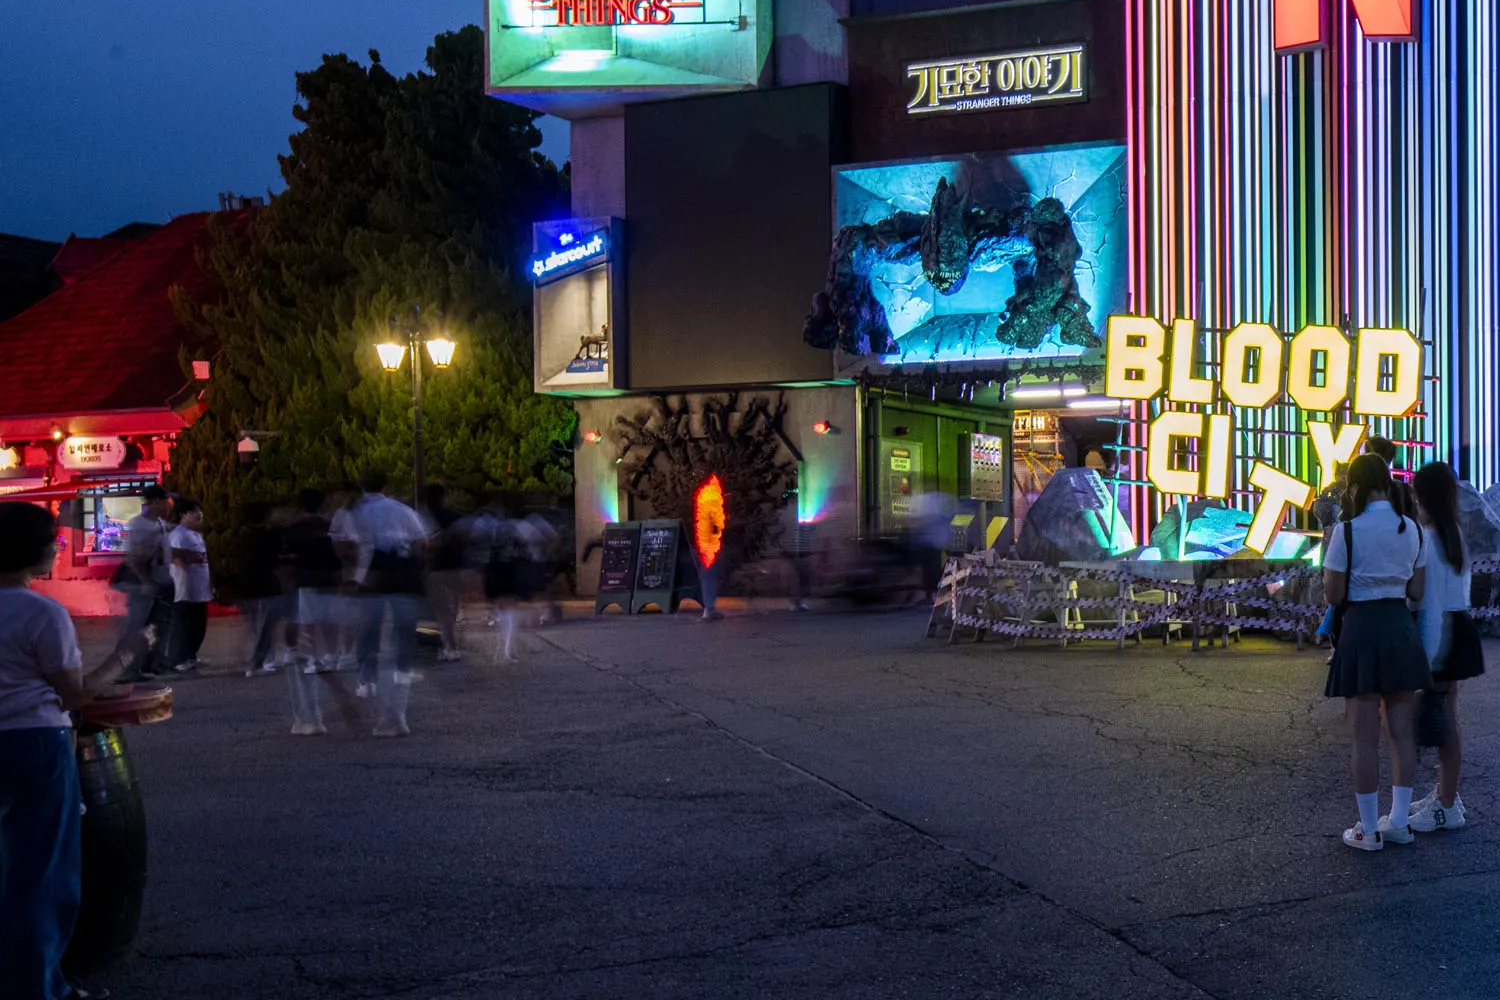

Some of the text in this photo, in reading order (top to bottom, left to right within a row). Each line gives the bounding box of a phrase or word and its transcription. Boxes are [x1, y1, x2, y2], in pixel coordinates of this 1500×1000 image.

[907, 51, 1083, 109] 기묘한 이야기
[956, 94, 1032, 111] STRANGER THINGS
[1105, 315, 1423, 417] BLOOD
[1147, 410, 1370, 555] CITY
